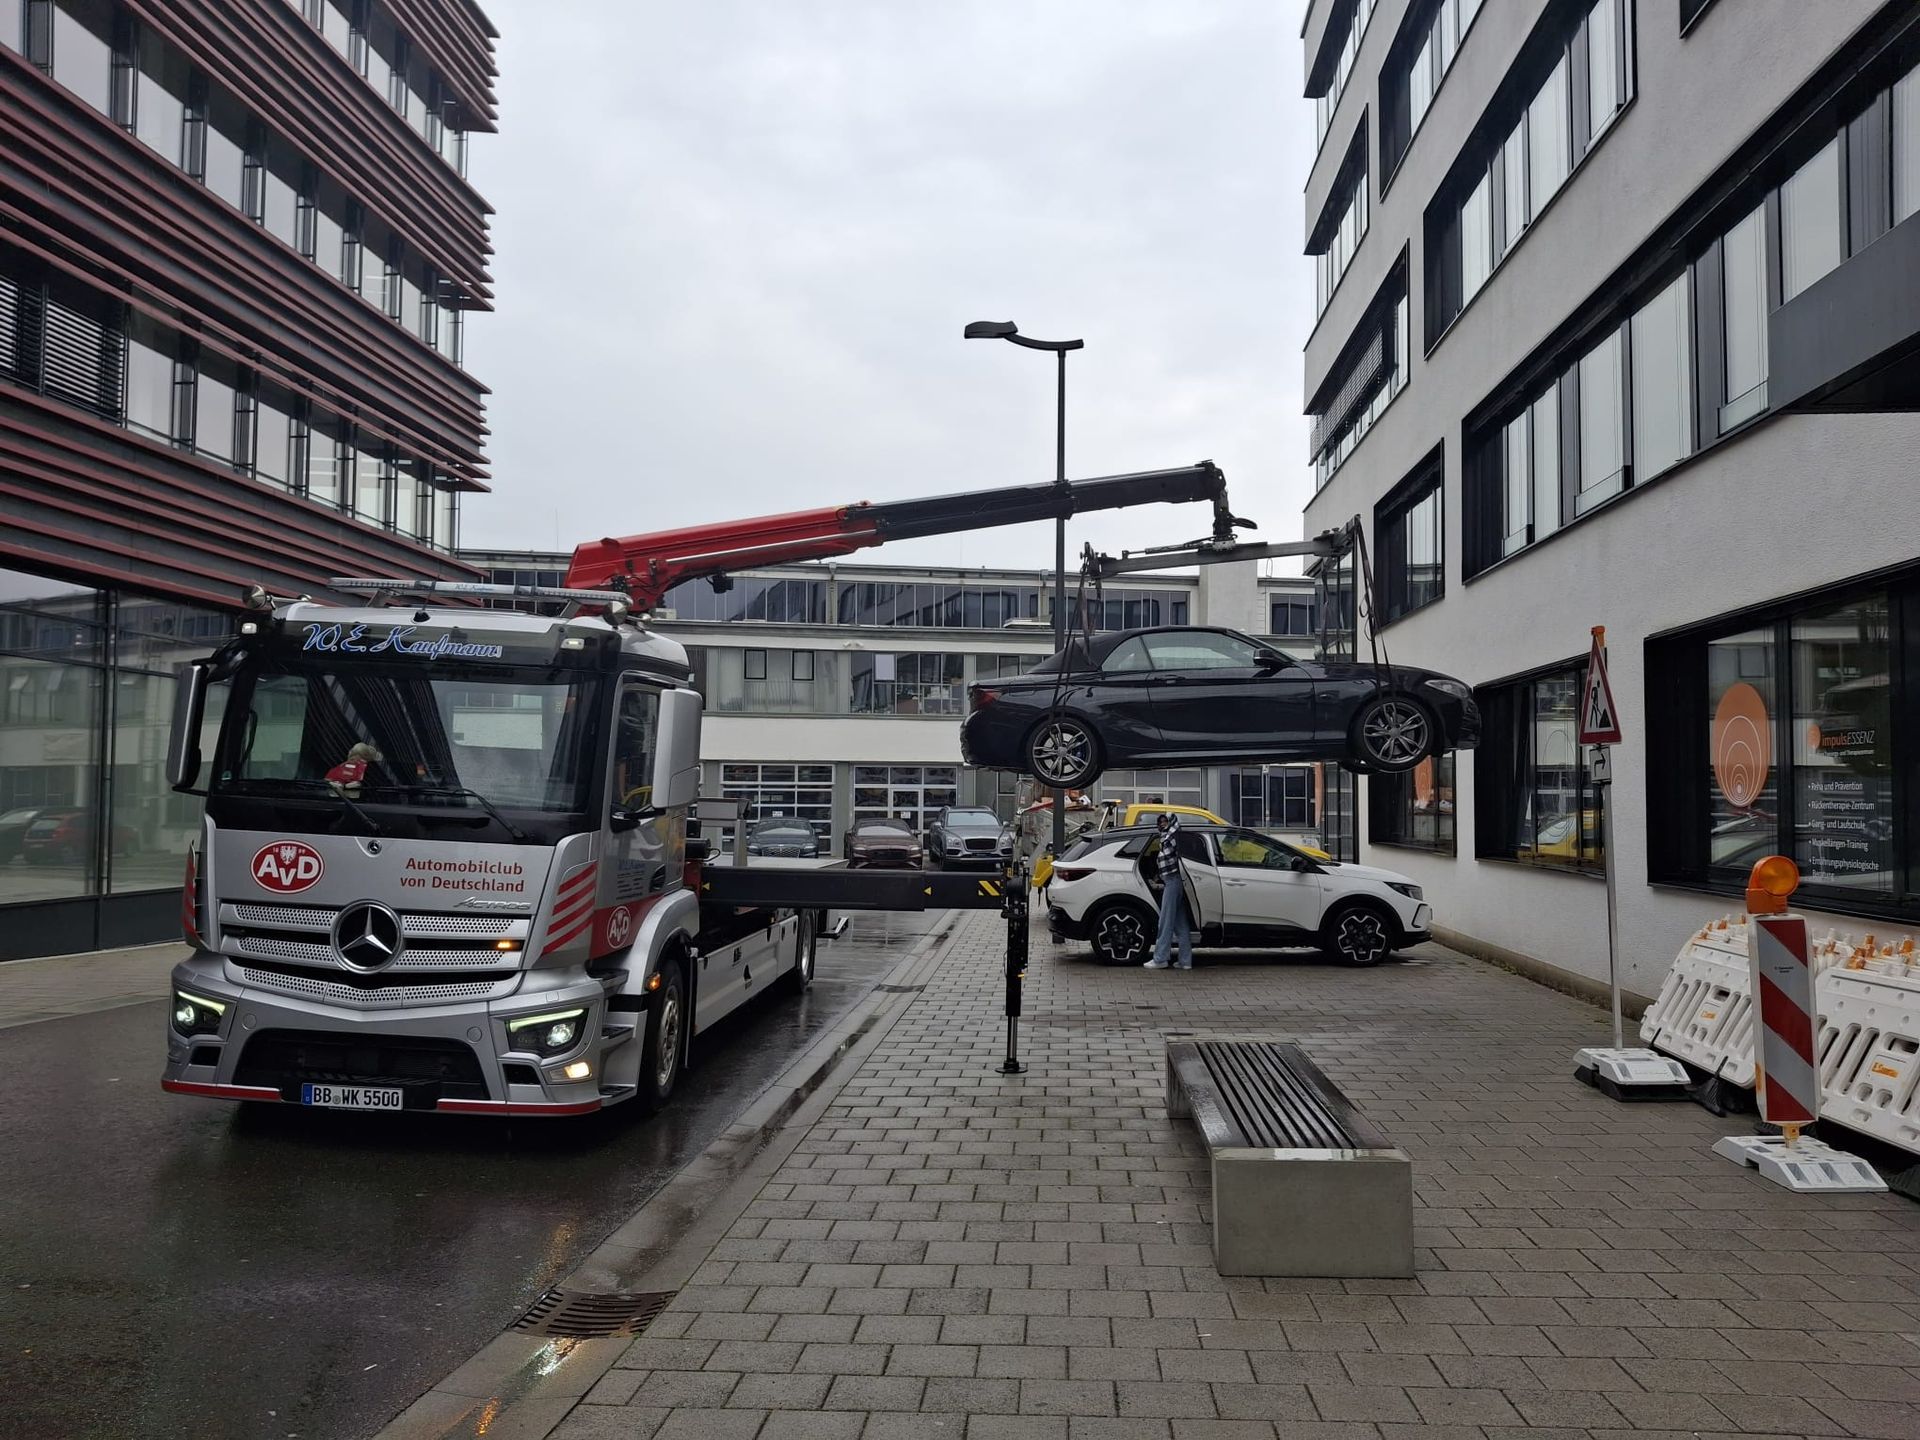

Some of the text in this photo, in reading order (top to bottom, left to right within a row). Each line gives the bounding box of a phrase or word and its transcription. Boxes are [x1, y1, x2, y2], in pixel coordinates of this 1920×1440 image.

[369, 626, 502, 660] Kaufmann
[1824, 781, 1834, 791] und
[1835, 781, 1864, 791] Prävention
[1811, 800, 1875, 812] Rückentherapie-Zentrum
[1827, 820, 1837, 829] und
[1837, 820, 1866, 830] Laufschule
[405, 857, 523, 875] Automobilclub
[400, 876, 525, 893] von Deutschland
[313, 1087, 400, 1107] BB WK 5500
